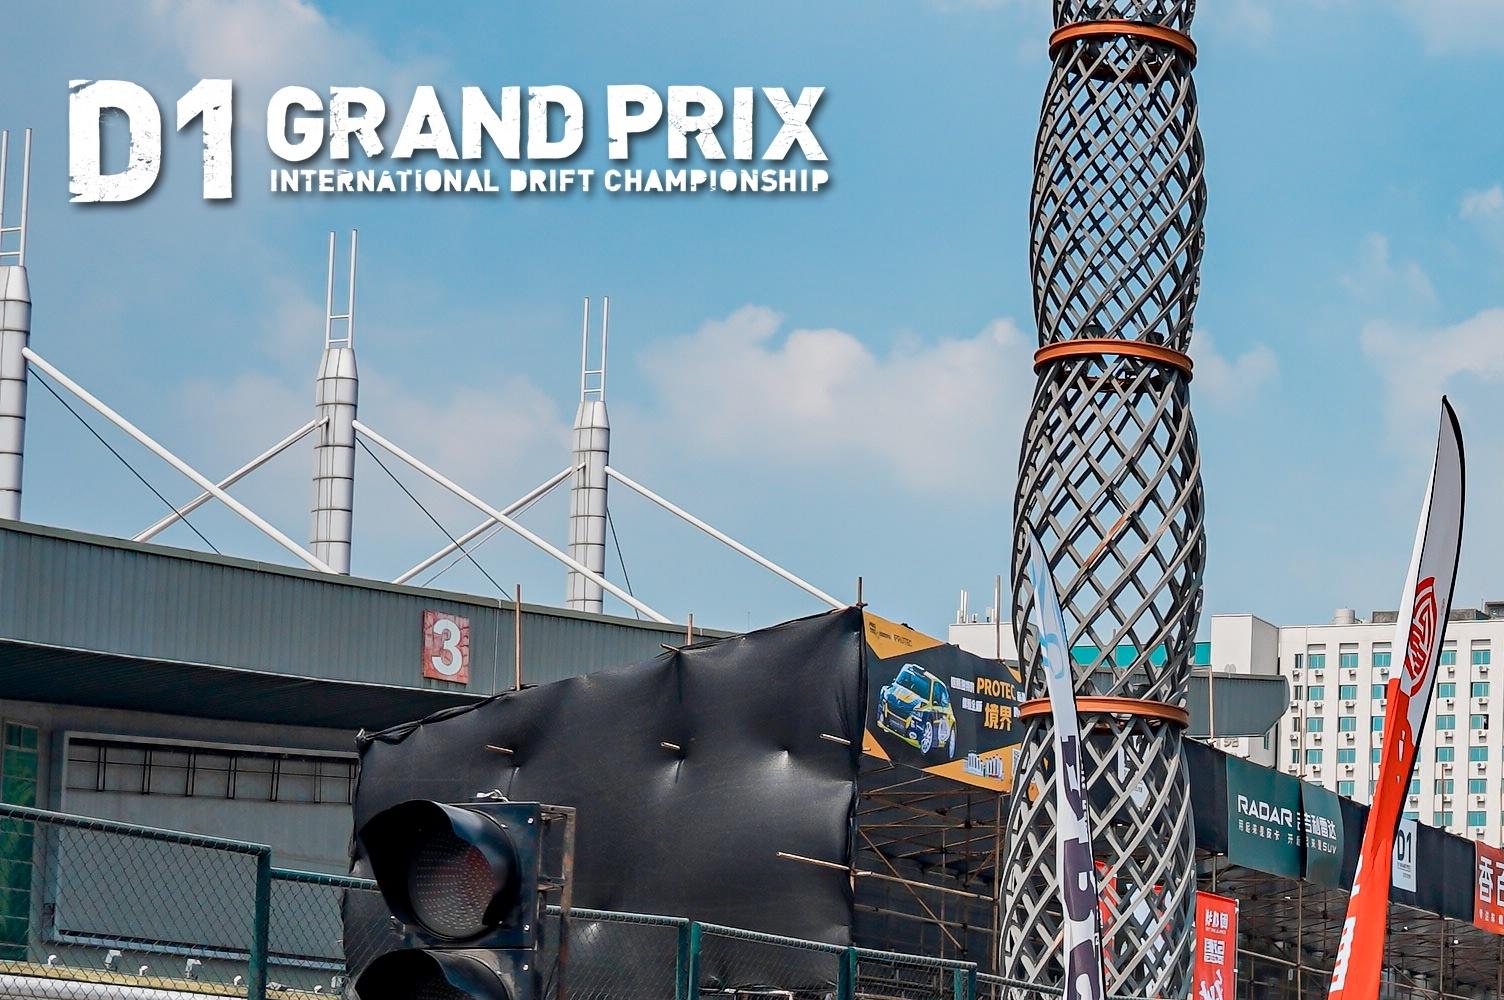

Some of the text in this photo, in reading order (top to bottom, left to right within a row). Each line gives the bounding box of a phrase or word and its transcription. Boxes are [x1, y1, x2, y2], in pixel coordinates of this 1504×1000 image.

[432, 617, 464, 678] 3
[984, 702, 1013, 731] 境界
[1237, 794, 1293, 828] RADAR
[1397, 829, 1413, 863] D1
